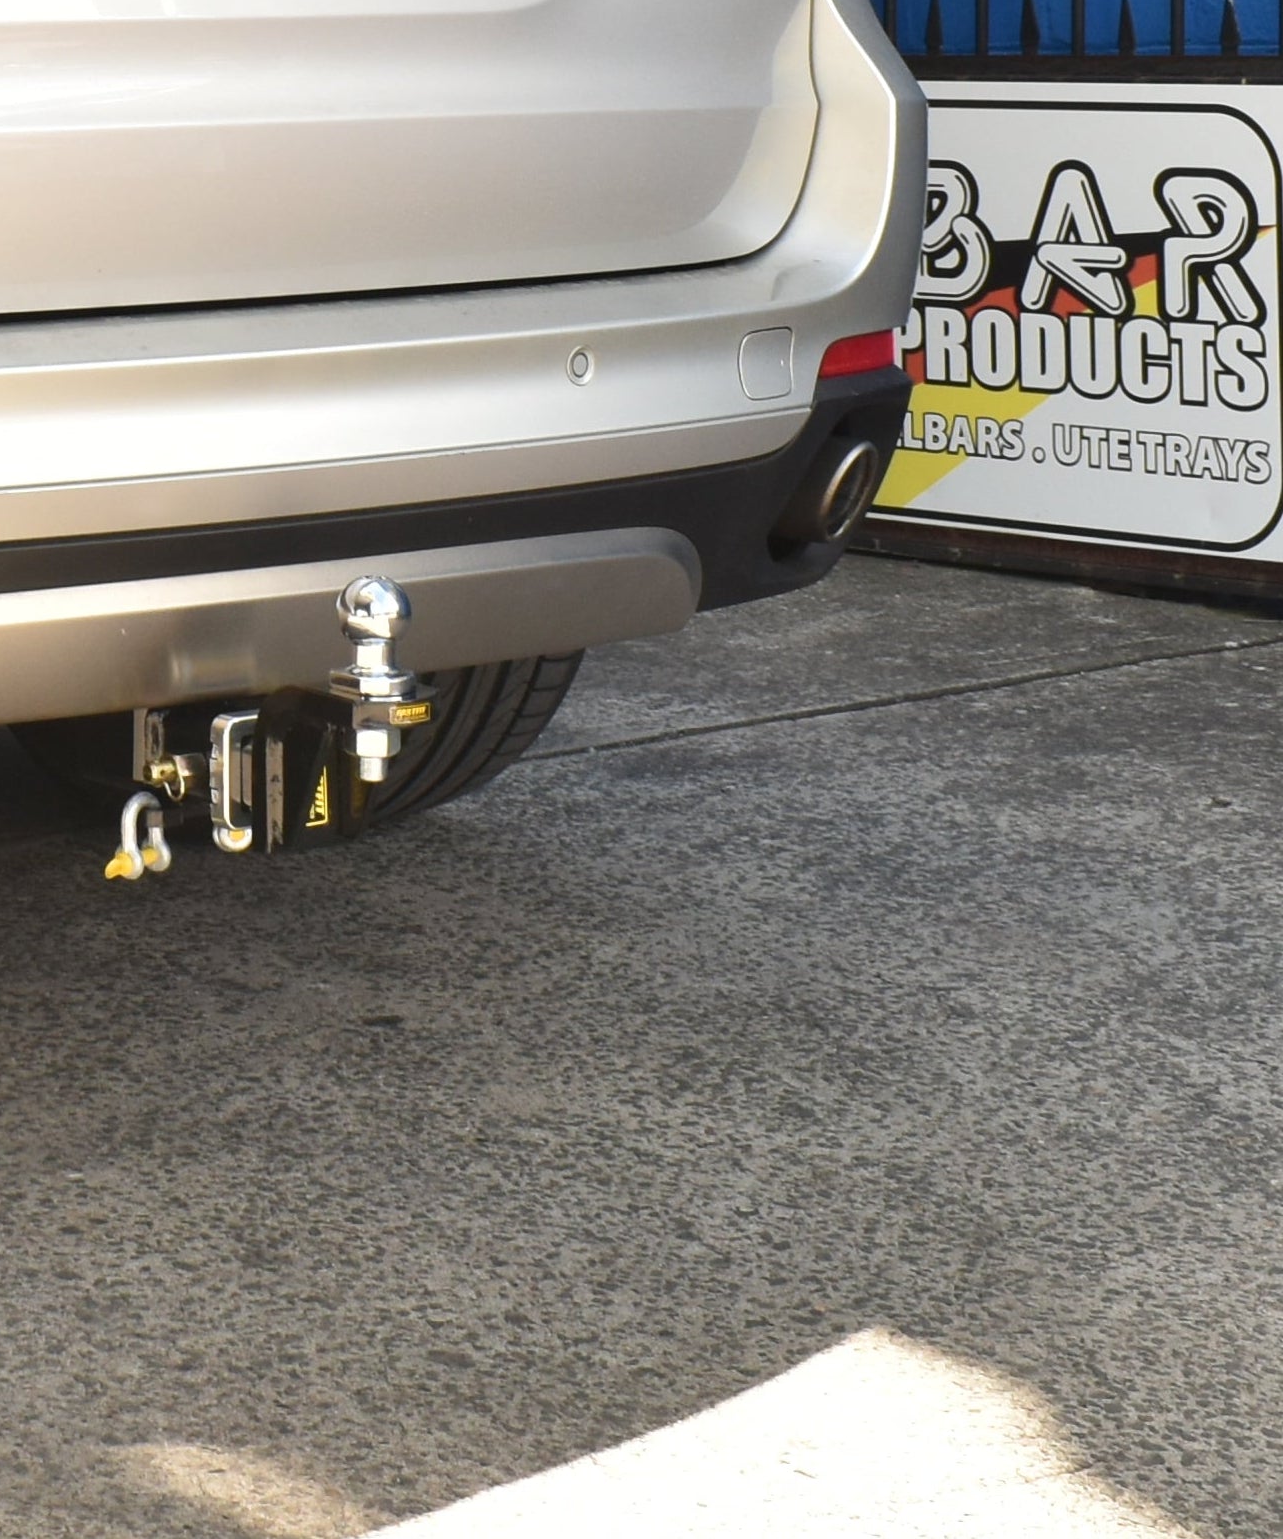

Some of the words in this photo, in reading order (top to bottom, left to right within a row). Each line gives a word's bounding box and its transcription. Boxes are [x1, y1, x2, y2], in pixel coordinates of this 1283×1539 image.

[896, 412, 1025, 461] LBARS
[1052, 423, 1132, 471] UTE
[1136, 431, 1273, 485] TRAYS
